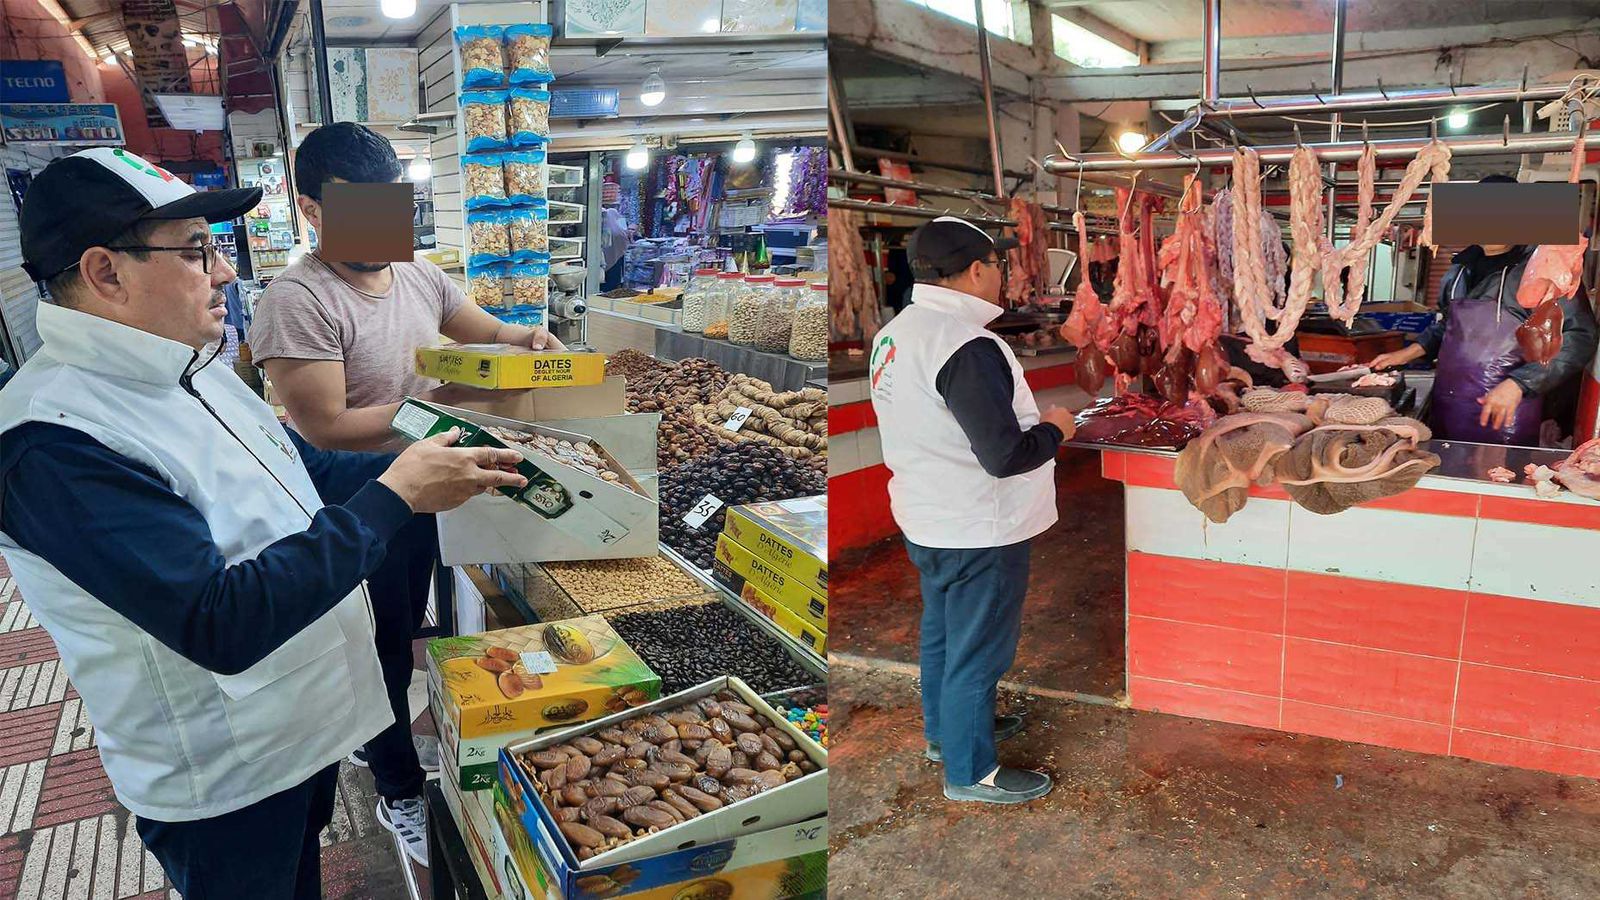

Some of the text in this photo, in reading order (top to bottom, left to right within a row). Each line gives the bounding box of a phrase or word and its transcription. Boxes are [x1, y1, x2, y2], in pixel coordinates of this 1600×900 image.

[4, 76, 56, 88] TECNO
[534, 359, 572, 369] DATES
[730, 412, 746, 422] 60
[532, 493, 554, 508] OASIS
[693, 501, 716, 517] 35
[759, 532, 794, 559] DATTES
[751, 559, 785, 586] DATTES
